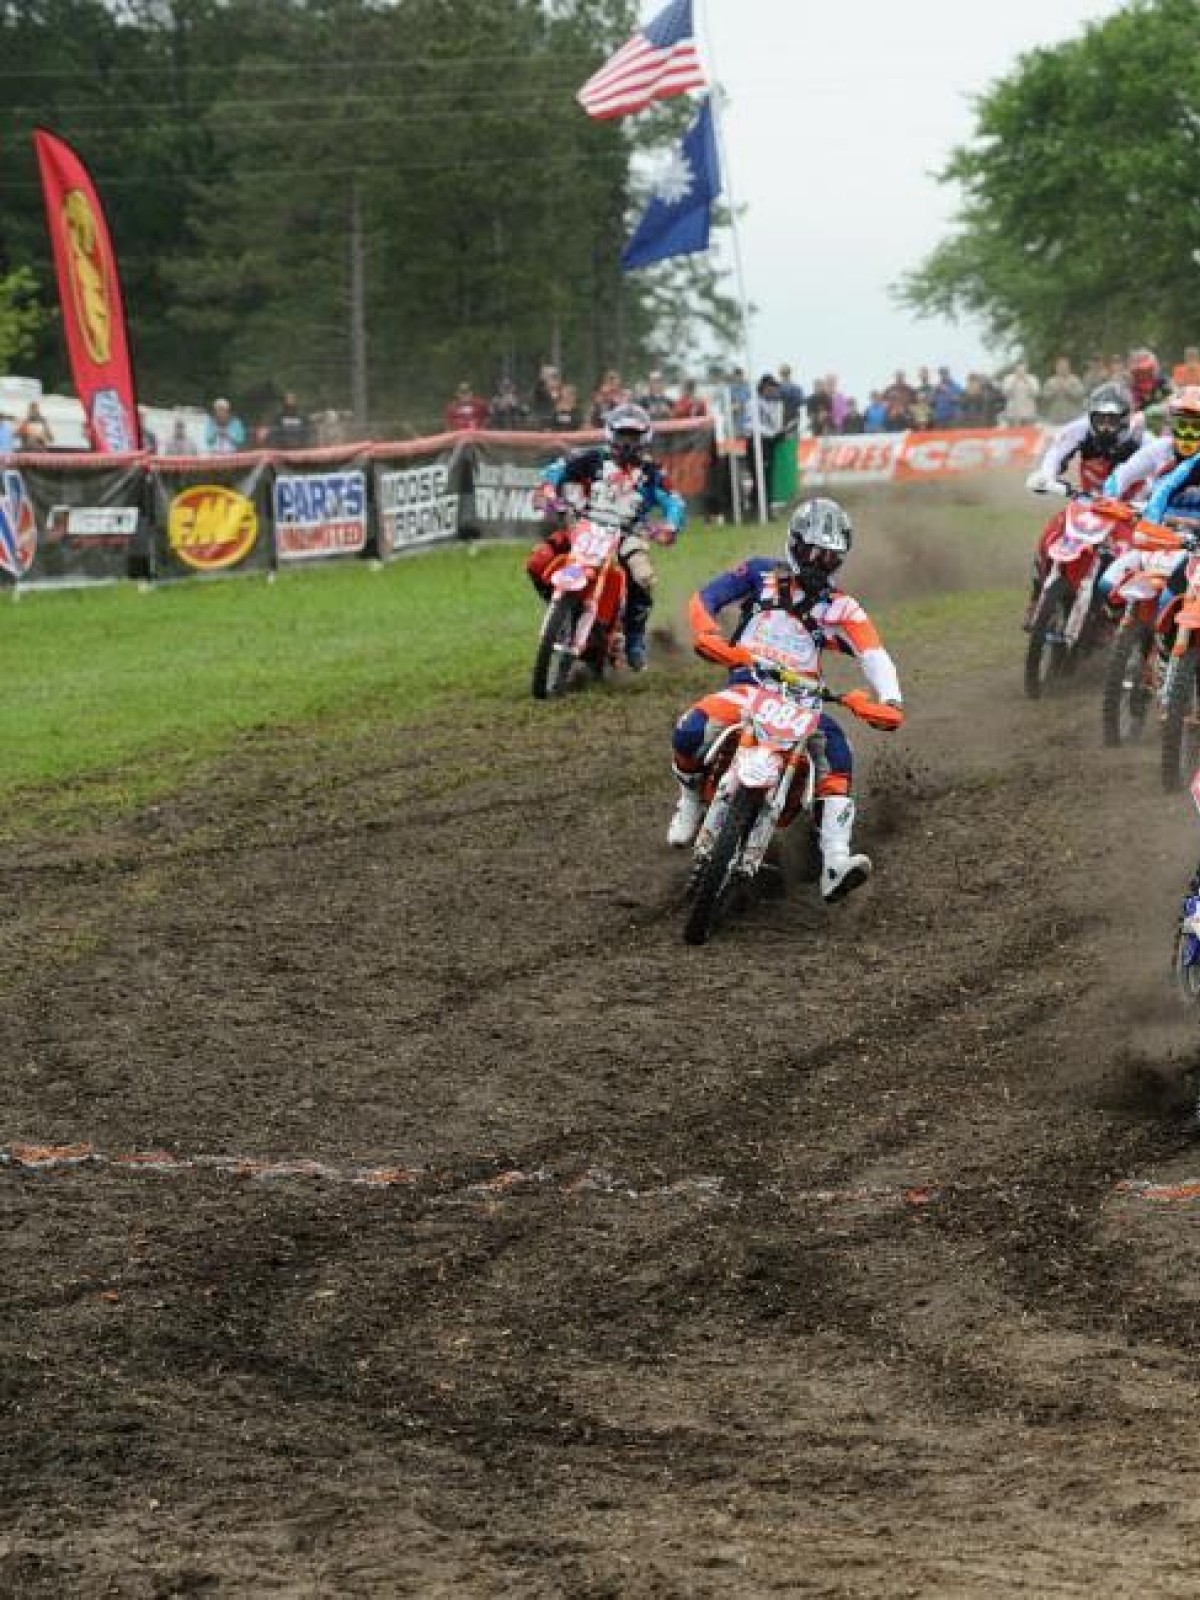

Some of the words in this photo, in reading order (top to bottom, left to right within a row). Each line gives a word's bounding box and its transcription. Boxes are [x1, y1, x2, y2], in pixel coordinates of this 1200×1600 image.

[815, 443, 893, 474] TIRES
[906, 437, 1024, 470] CST
[277, 478, 364, 523] PARTS
[380, 466, 449, 511] MOOSE
[170, 495, 257, 547] FMF
[277, 521, 364, 553] UNLIMITED
[380, 497, 458, 556] RACING
[757, 698, 813, 737] 984
